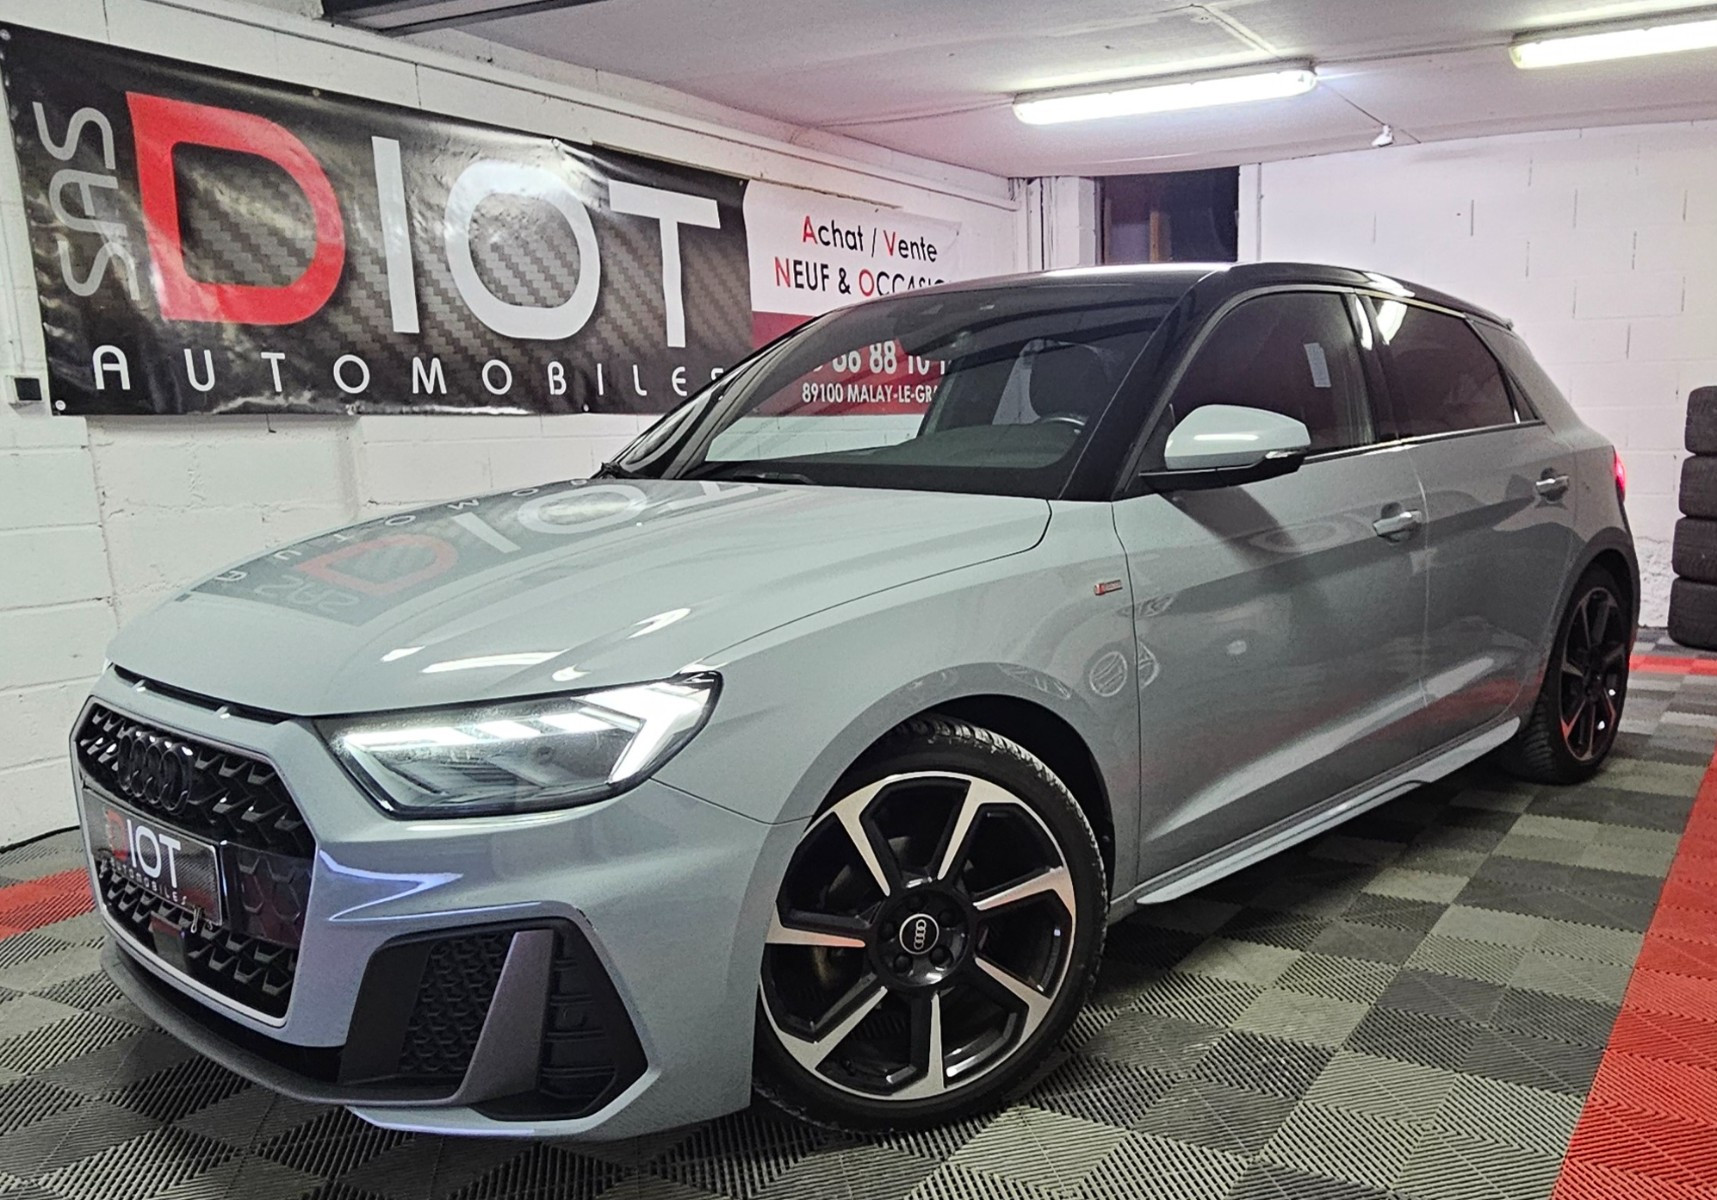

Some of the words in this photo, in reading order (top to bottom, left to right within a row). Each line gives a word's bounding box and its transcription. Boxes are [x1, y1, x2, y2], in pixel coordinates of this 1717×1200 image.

[125, 91, 721, 348] DIOT
[802, 215, 864, 252] Achat
[871, 227, 877, 258] /
[883, 229, 938, 263] Vente
[774, 256, 830, 292] NEUF
[838, 267, 852, 295] &
[869, 340, 898, 375] 88
[801, 382, 844, 404] 89100
[847, 384, 938, 404] MALAY-LE-GR
[104, 807, 182, 889] DIOT
